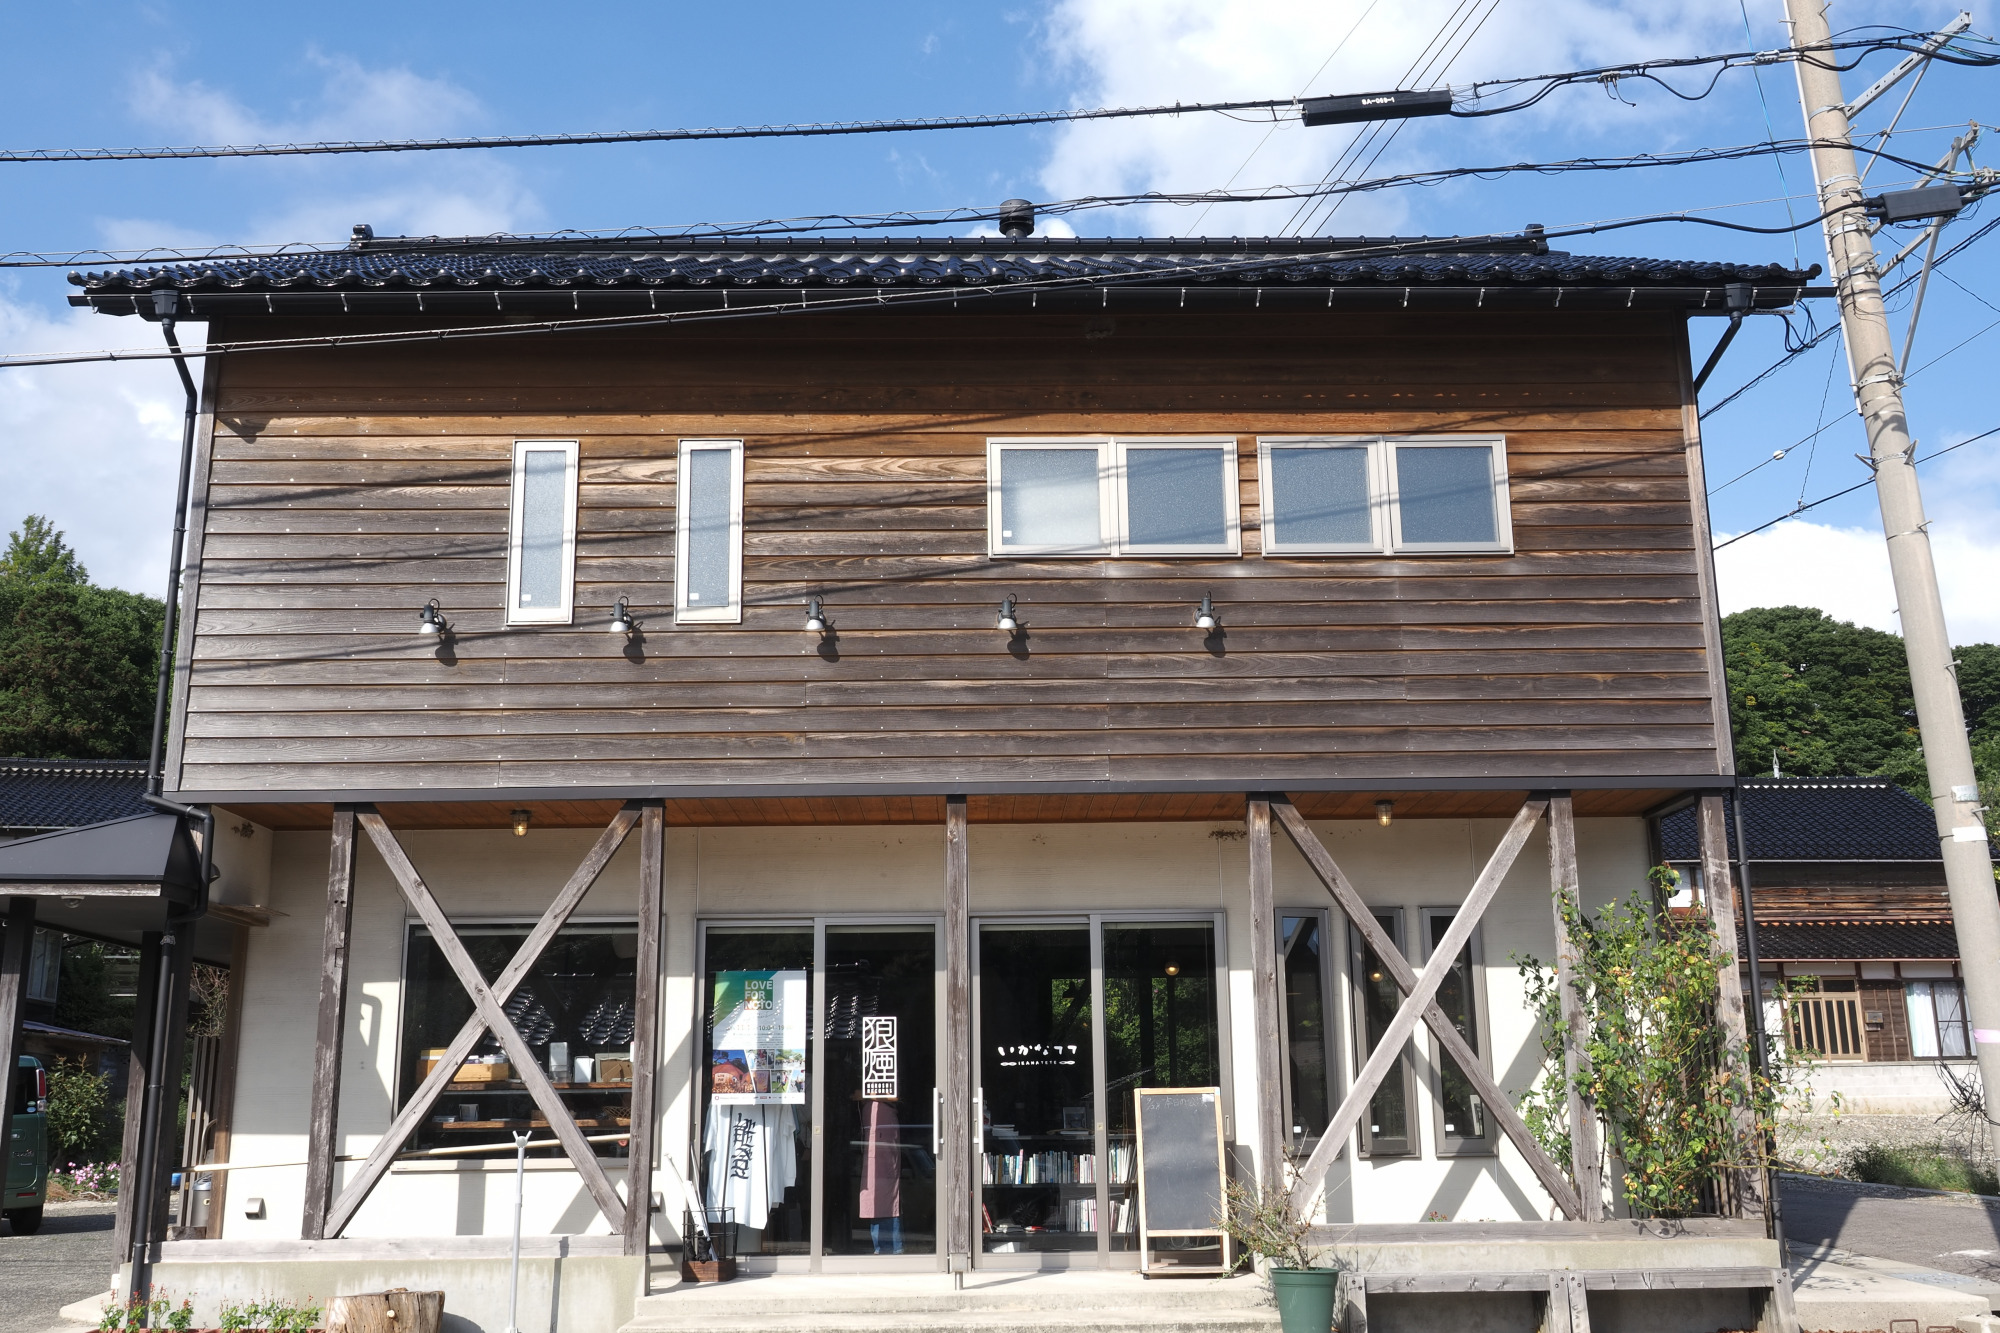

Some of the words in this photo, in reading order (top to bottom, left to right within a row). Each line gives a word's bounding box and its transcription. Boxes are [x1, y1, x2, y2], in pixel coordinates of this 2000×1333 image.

[745, 981, 773, 990] LOVE
[745, 991, 765, 999] FOR
[744, 1000, 773, 1009] NOTO
[864, 1018, 895, 1081] 狼煙
